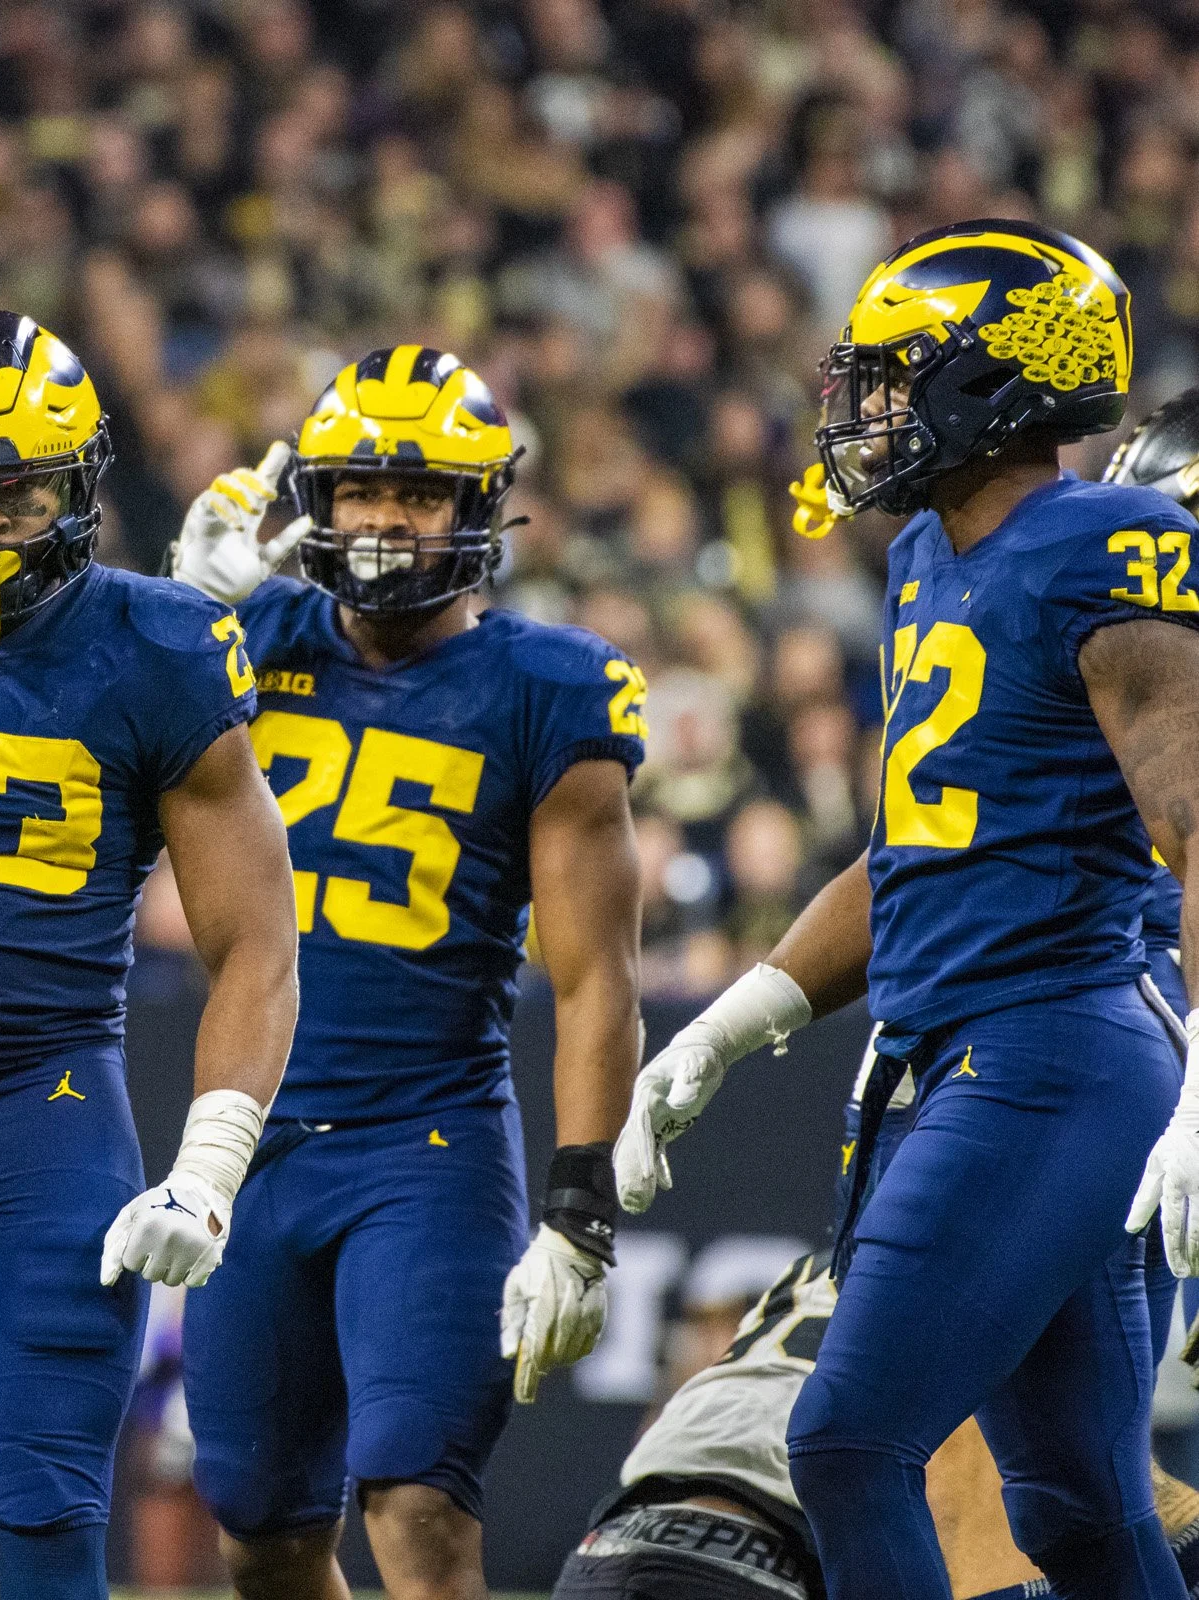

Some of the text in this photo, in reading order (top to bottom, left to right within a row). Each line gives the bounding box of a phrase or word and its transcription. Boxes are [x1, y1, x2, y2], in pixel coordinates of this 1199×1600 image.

[1107, 530, 1199, 612] 32
[211, 610, 257, 699] 2
[248, 709, 486, 952] 25
